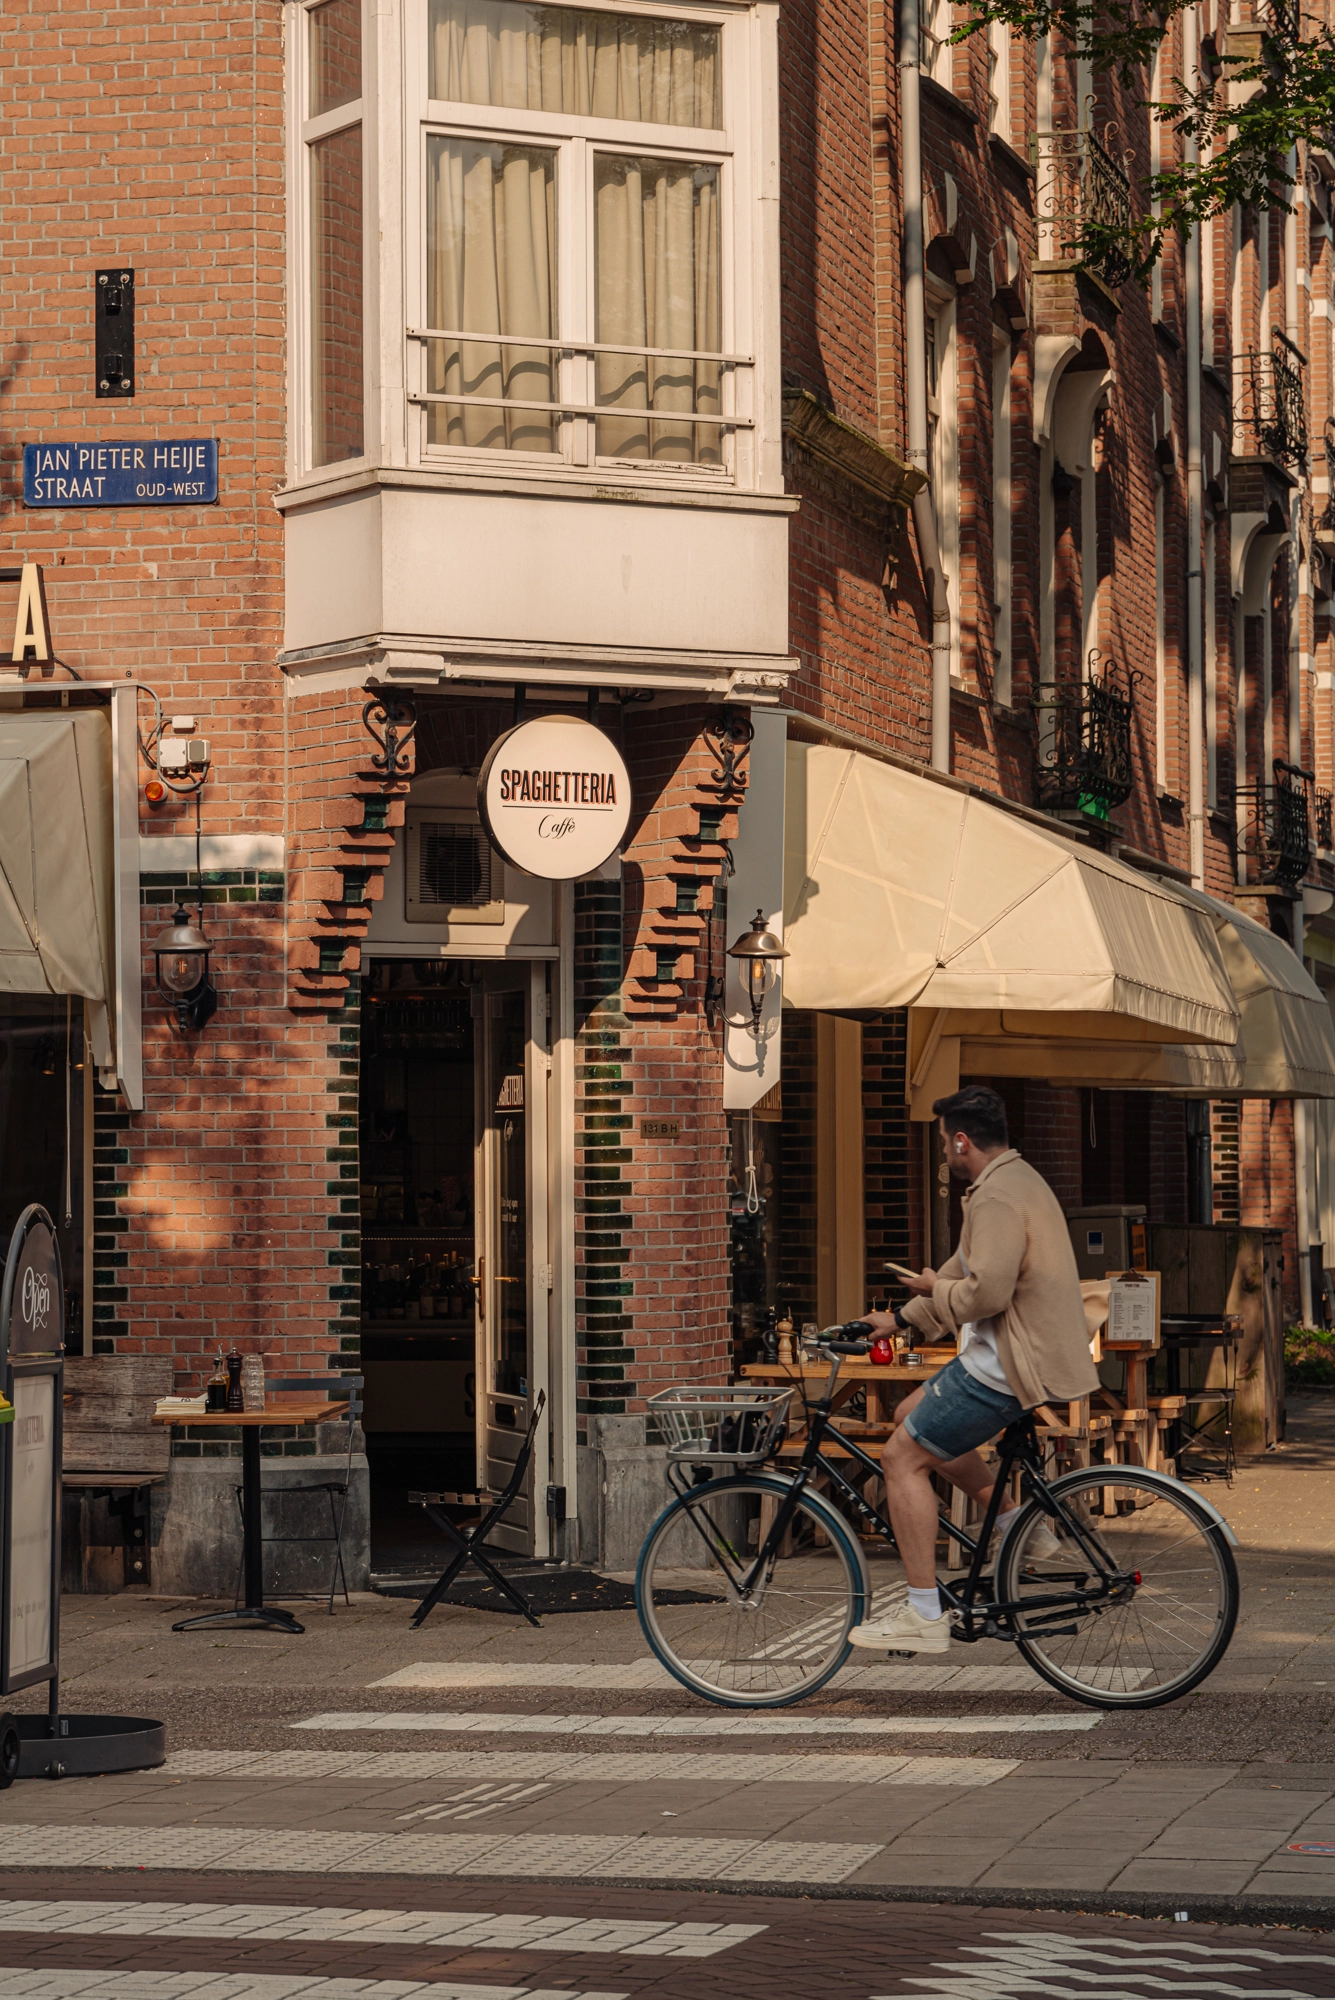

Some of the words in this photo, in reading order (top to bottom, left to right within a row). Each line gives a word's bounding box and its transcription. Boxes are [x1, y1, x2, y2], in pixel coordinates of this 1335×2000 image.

[34, 449, 70, 477] JAN
[79, 447, 146, 470] PIETER
[153, 446, 206, 474] HEIJE
[34, 476, 106, 499] STRAAT
[136, 482, 206, 497] OUD-WEST
[500, 769, 617, 805] SPAGHETTERIA
[538, 814, 576, 839] Caffè
[643, 1123, 658, 1133] 131
[661, 1123, 668, 1133] B
[670, 1123, 678, 1133] H
[22, 1266, 50, 1332] Open
[847, 1493, 889, 1534] SWAP
